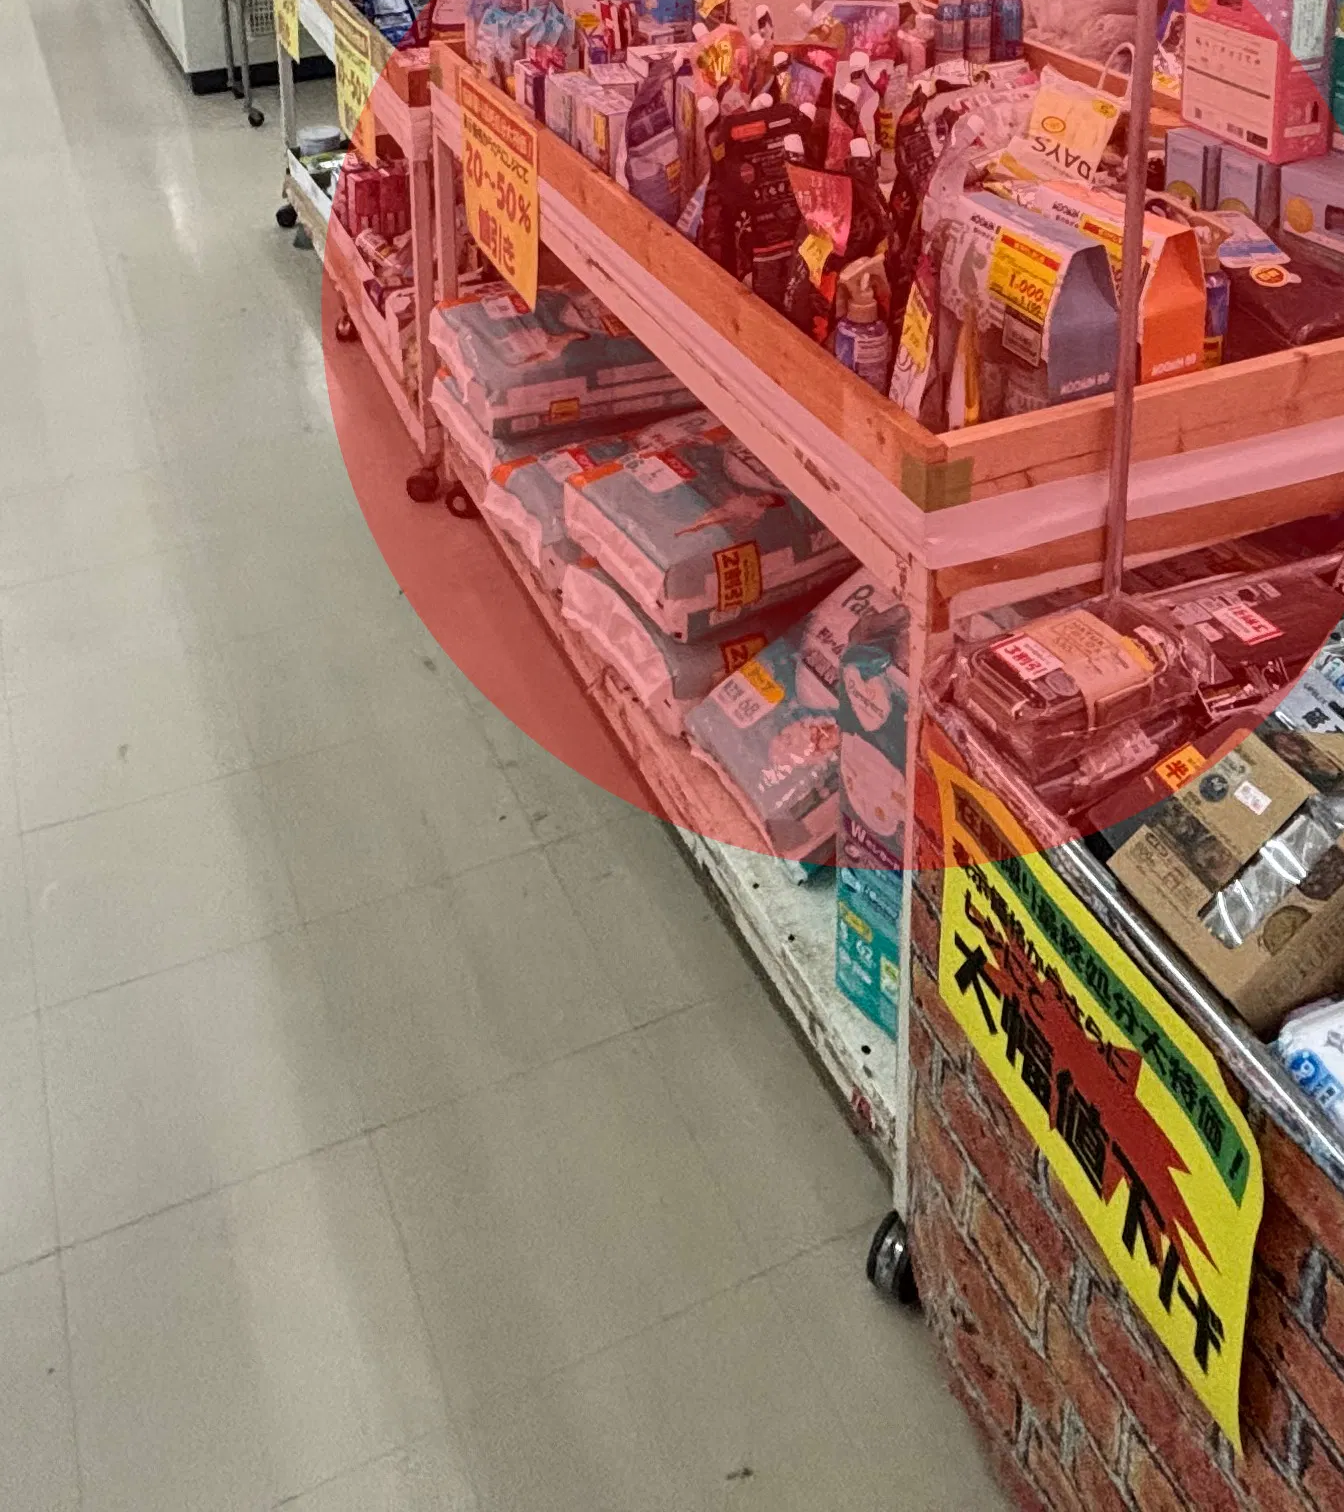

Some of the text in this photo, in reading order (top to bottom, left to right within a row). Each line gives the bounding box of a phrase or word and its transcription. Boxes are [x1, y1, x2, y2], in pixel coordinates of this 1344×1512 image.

[955, 931, 1227, 1375] 大幅値下げ
